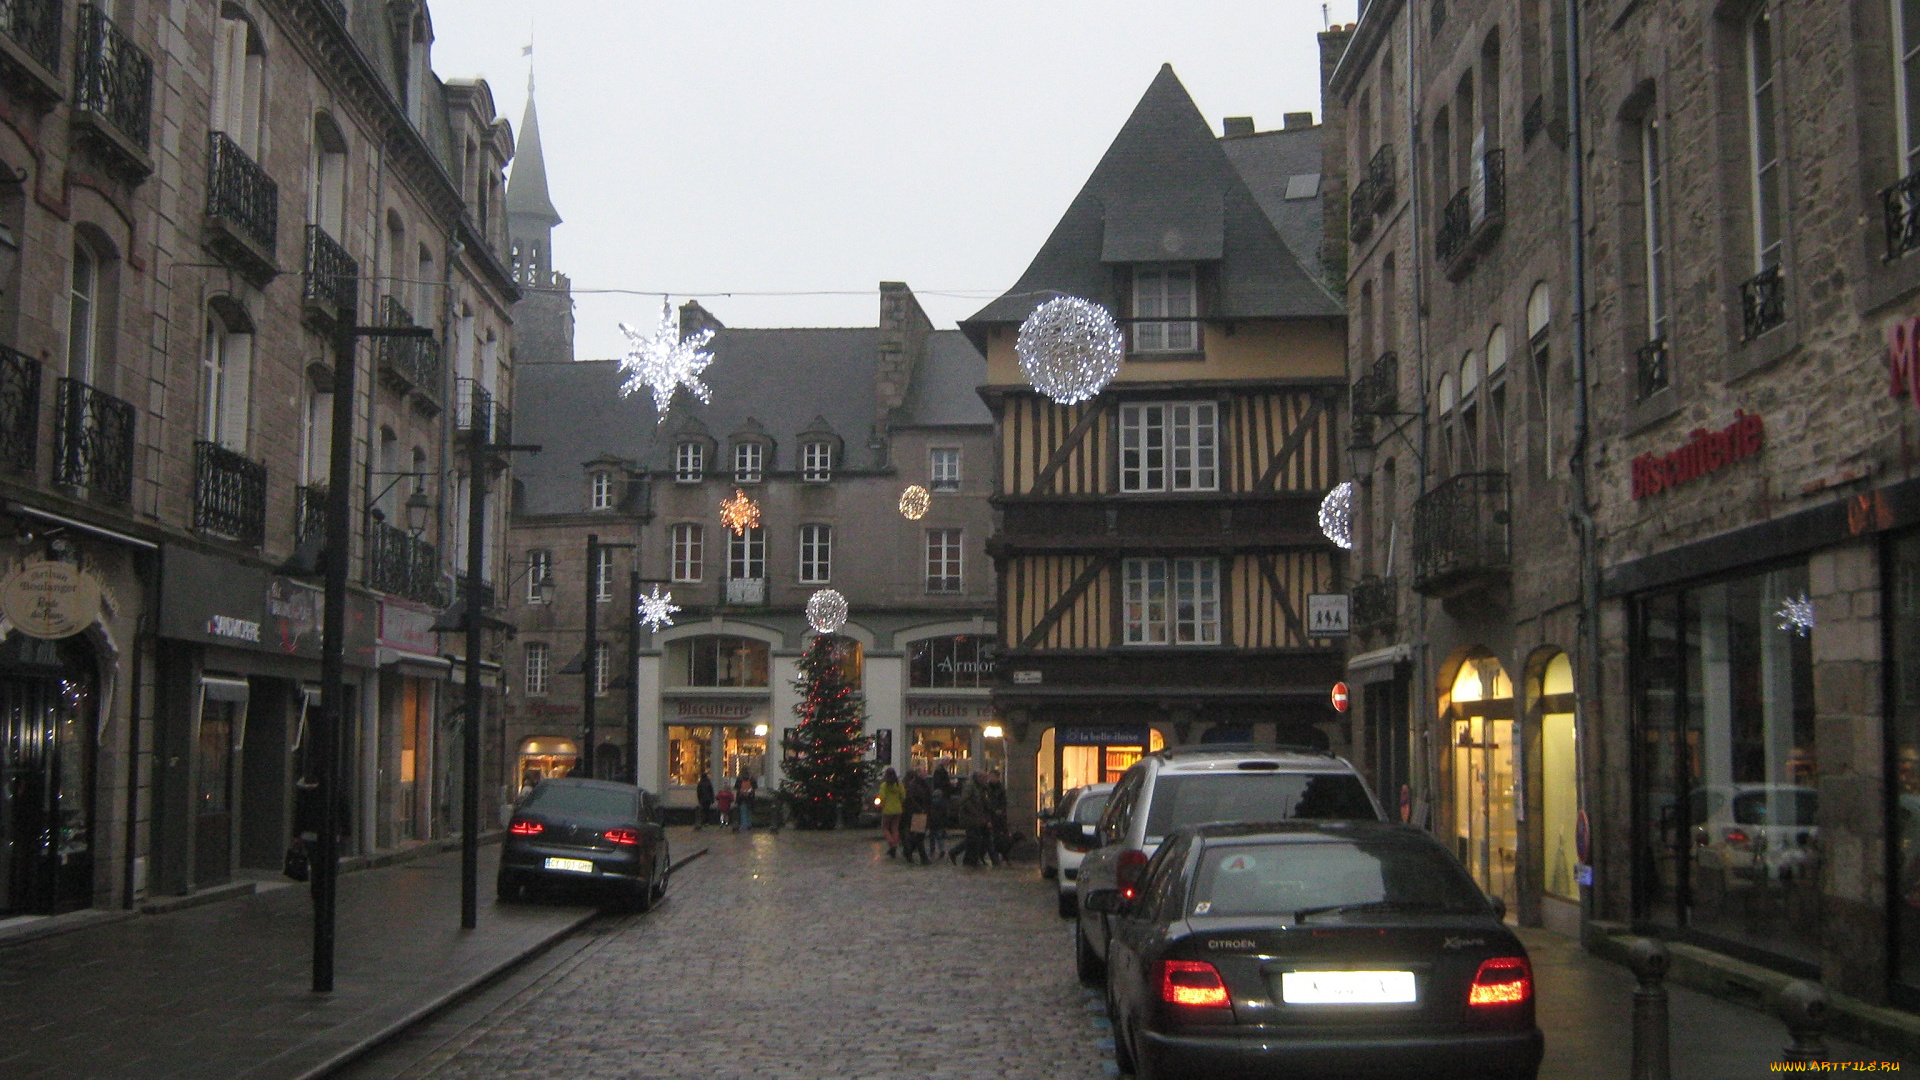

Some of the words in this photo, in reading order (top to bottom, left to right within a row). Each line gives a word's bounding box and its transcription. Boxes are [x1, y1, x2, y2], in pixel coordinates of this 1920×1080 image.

[1631, 407, 1764, 500] Biscuiterie
[20, 581, 77, 594] Boulanger
[677, 701, 753, 716] Biscuiterie
[906, 702, 968, 717] Produits
[1228, 857, 1245, 871] A
